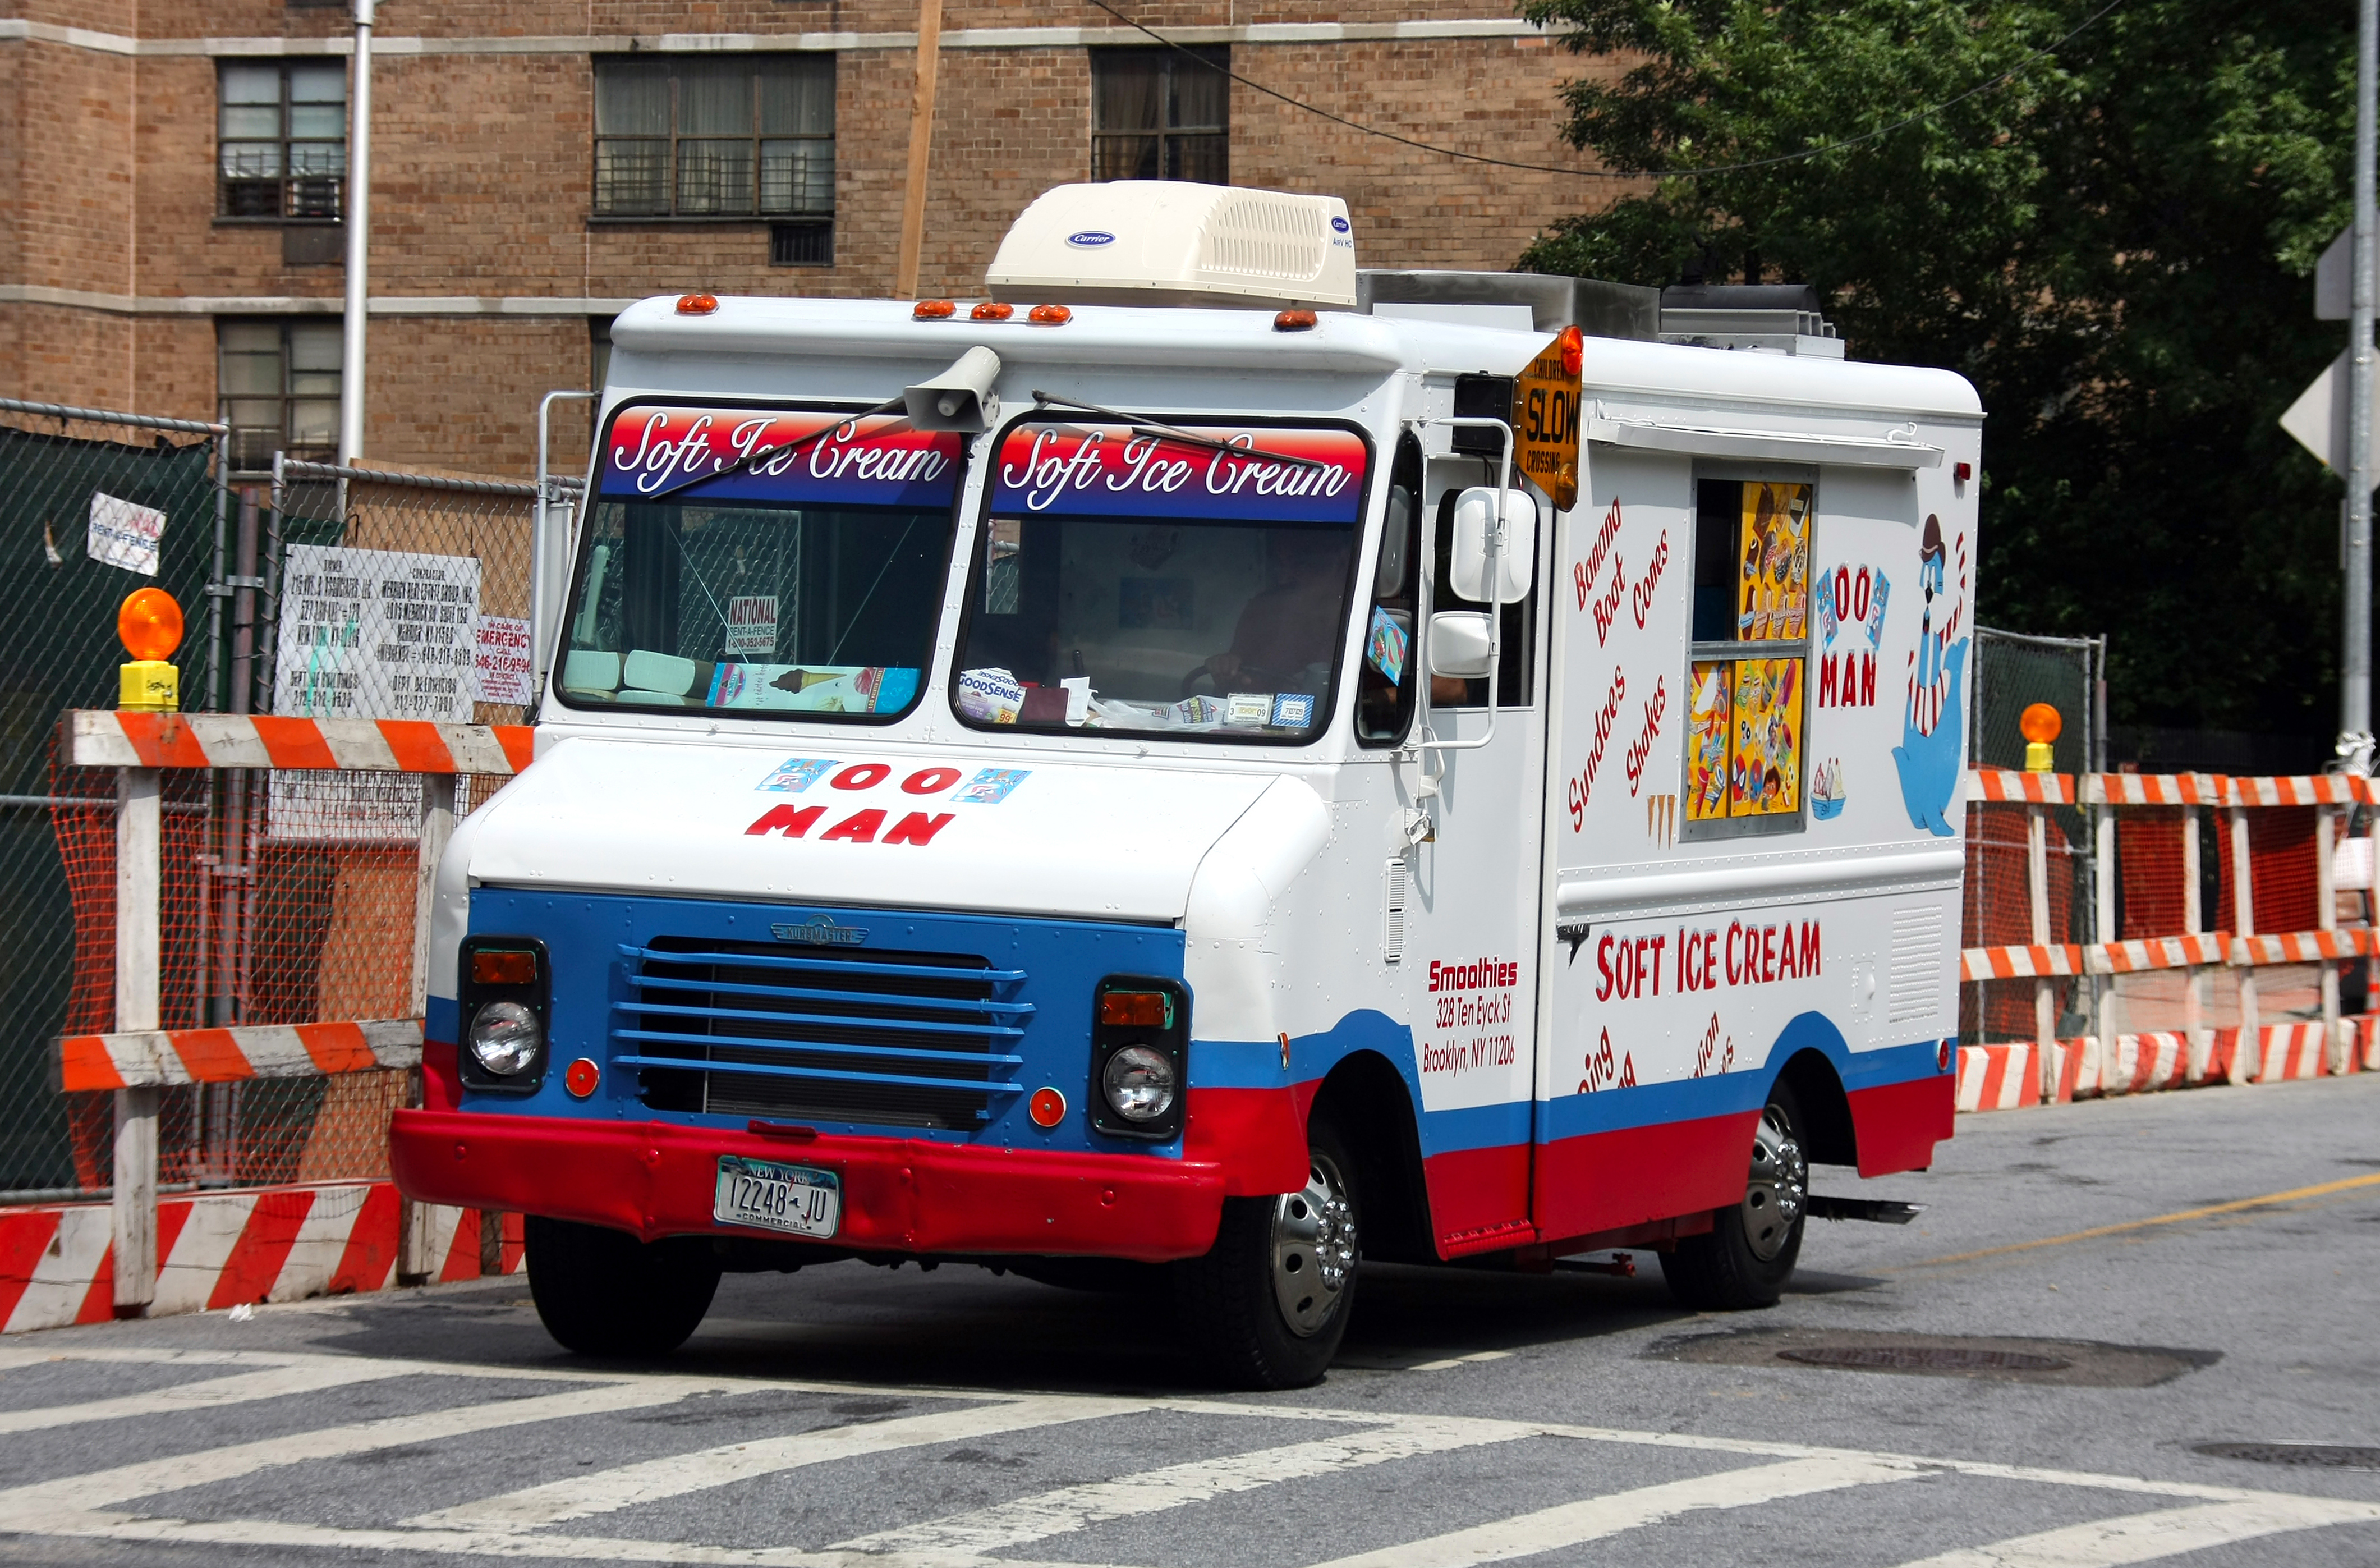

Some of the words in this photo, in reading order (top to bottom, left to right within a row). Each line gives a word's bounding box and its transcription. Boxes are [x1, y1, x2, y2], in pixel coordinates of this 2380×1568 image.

[1074, 234, 1110, 244] Carrier
[1534, 357, 1565, 382] CHILDREN
[1526, 388, 1580, 445] SLOW
[614, 412, 714, 493] Soft
[713, 417, 797, 476] Ice
[809, 419, 949, 482] Cream
[1003, 428, 1105, 511] Soft
[1106, 434, 1194, 493] Ice
[1205, 432, 1352, 498] Cream
[1527, 450, 1560, 475] CROSSING
[1574, 494, 1622, 612] Banana
[1592, 550, 1626, 649] Boat
[1633, 528, 1669, 631] Cones
[730, 598, 776, 625] NATIONAL
[1818, 649, 1877, 708] MAN
[1229, 707, 1235, 716] 3
[1257, 708, 1266, 717] 09
[1569, 664, 1625, 834] Sundaes
[1627, 673, 1666, 799] Shakes
[744, 803, 957, 846] MAN
[787, 926, 853, 942] KURBMASTER
[1428, 956, 1518, 992] Smoothies
[1595, 929, 1666, 1003] SOFT
[1676, 924, 1718, 994] ICE
[1725, 917, 1821, 987] CREAM
[1436, 997, 1455, 1029] 328
[1458, 996, 1474, 1027] Ten
[1476, 993, 1501, 1033] Eyck
[1501, 992, 1511, 1024] St
[1423, 1039, 1468, 1078] Brooklyn,
[1471, 1037, 1487, 1069] NY
[1488, 1034, 1515, 1066] 11206
[748, 1163, 775, 1179] NEW
[779, 1167, 811, 1186] YORK
[742, 1213, 806, 1231] COMMERCIAL
